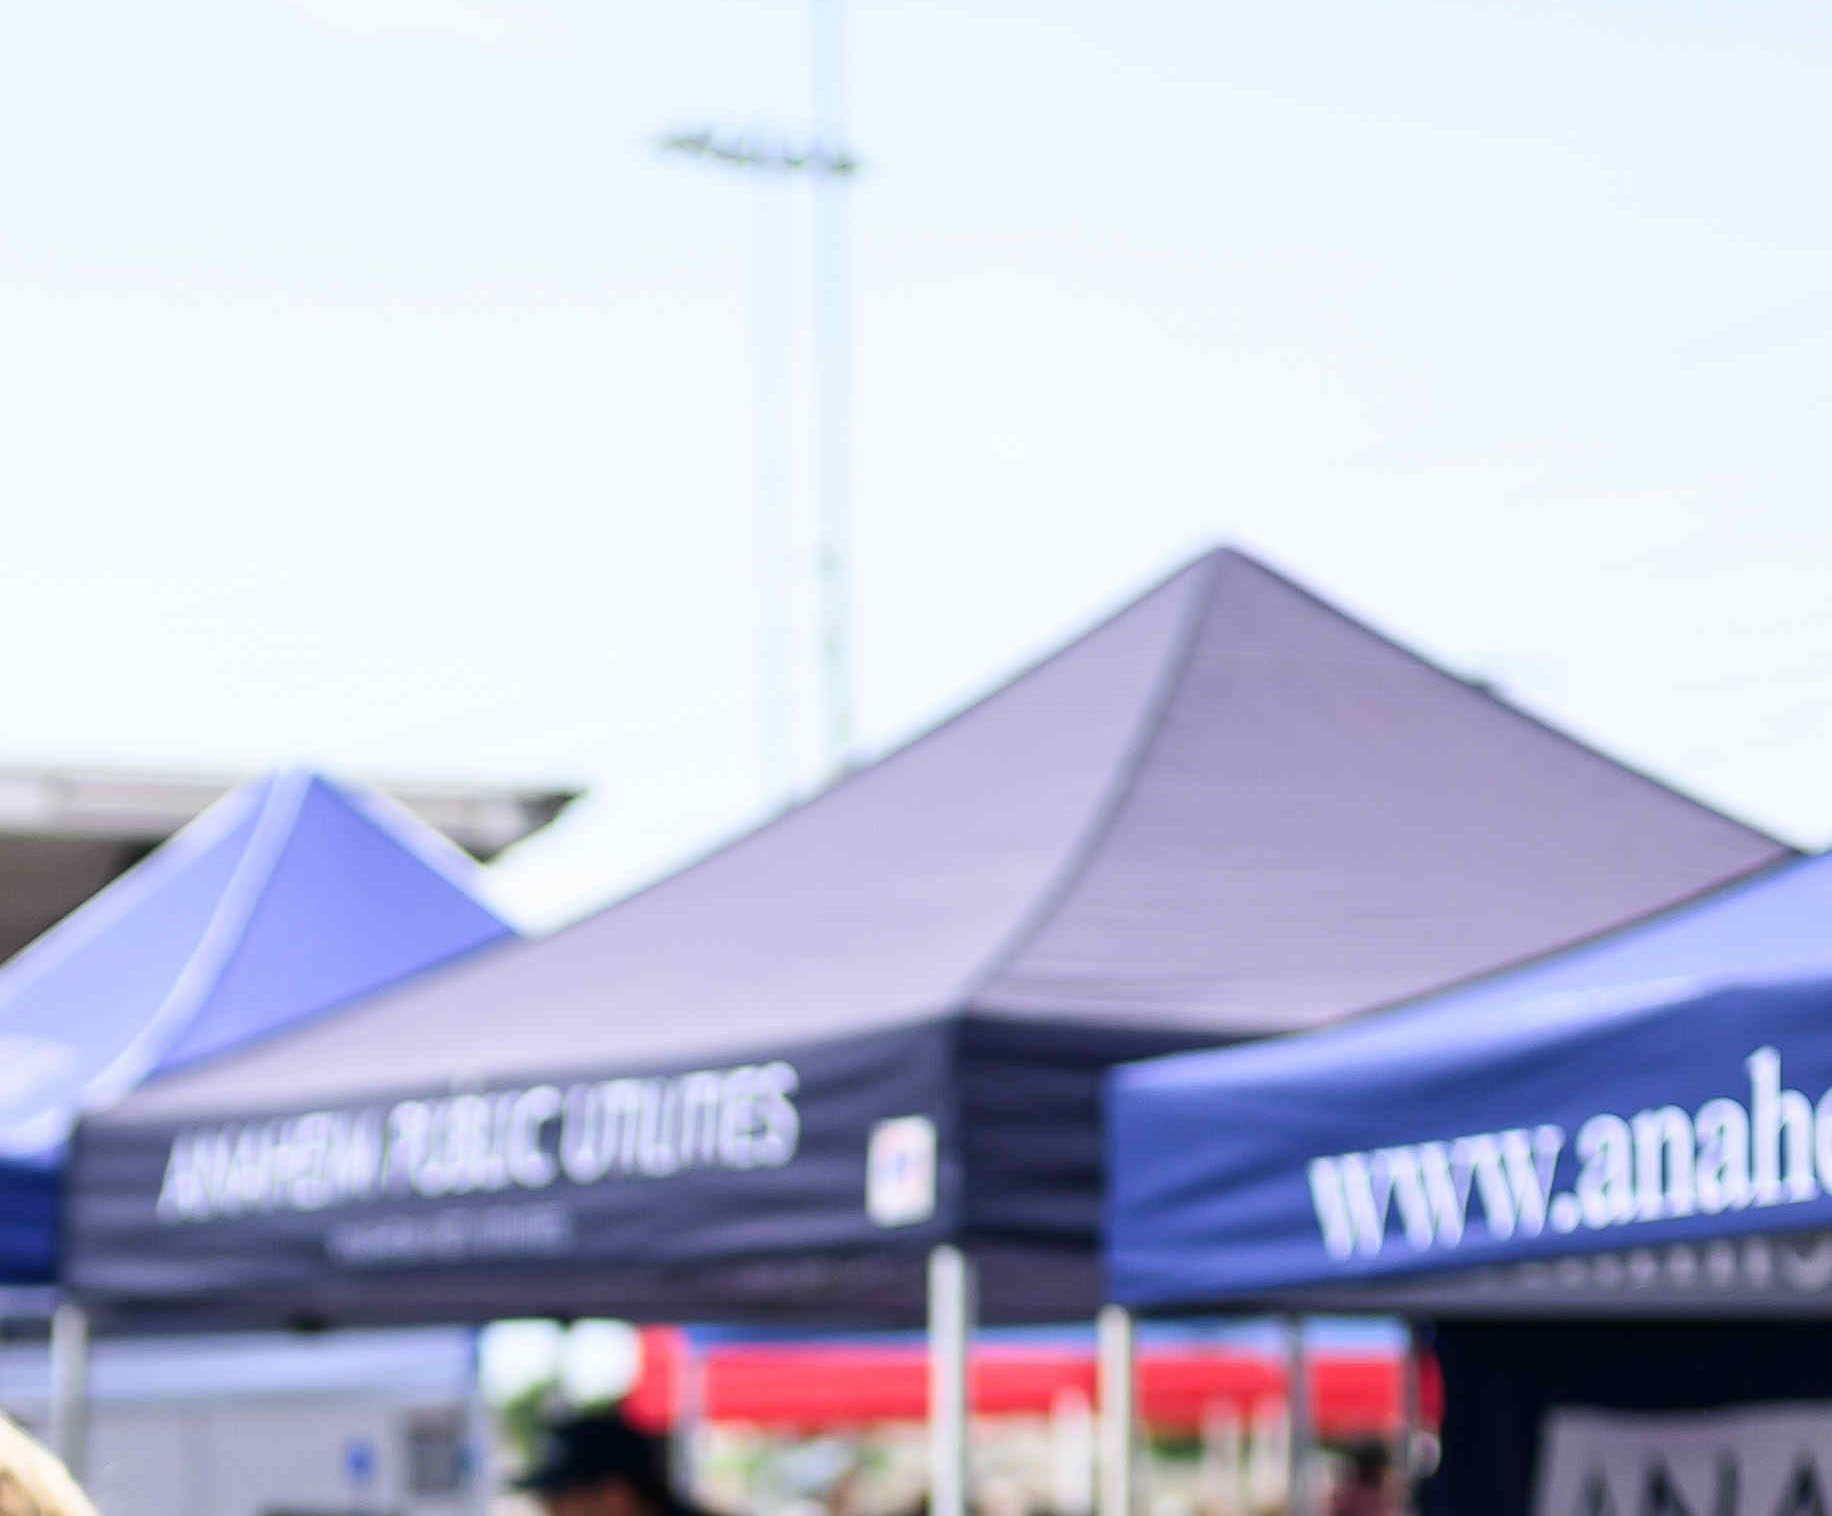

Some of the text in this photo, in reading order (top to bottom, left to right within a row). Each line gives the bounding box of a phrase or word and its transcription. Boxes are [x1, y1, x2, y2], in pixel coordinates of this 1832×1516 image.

[159, 1061, 799, 1222] ANAHEIM PUBLIC UTILITIES
